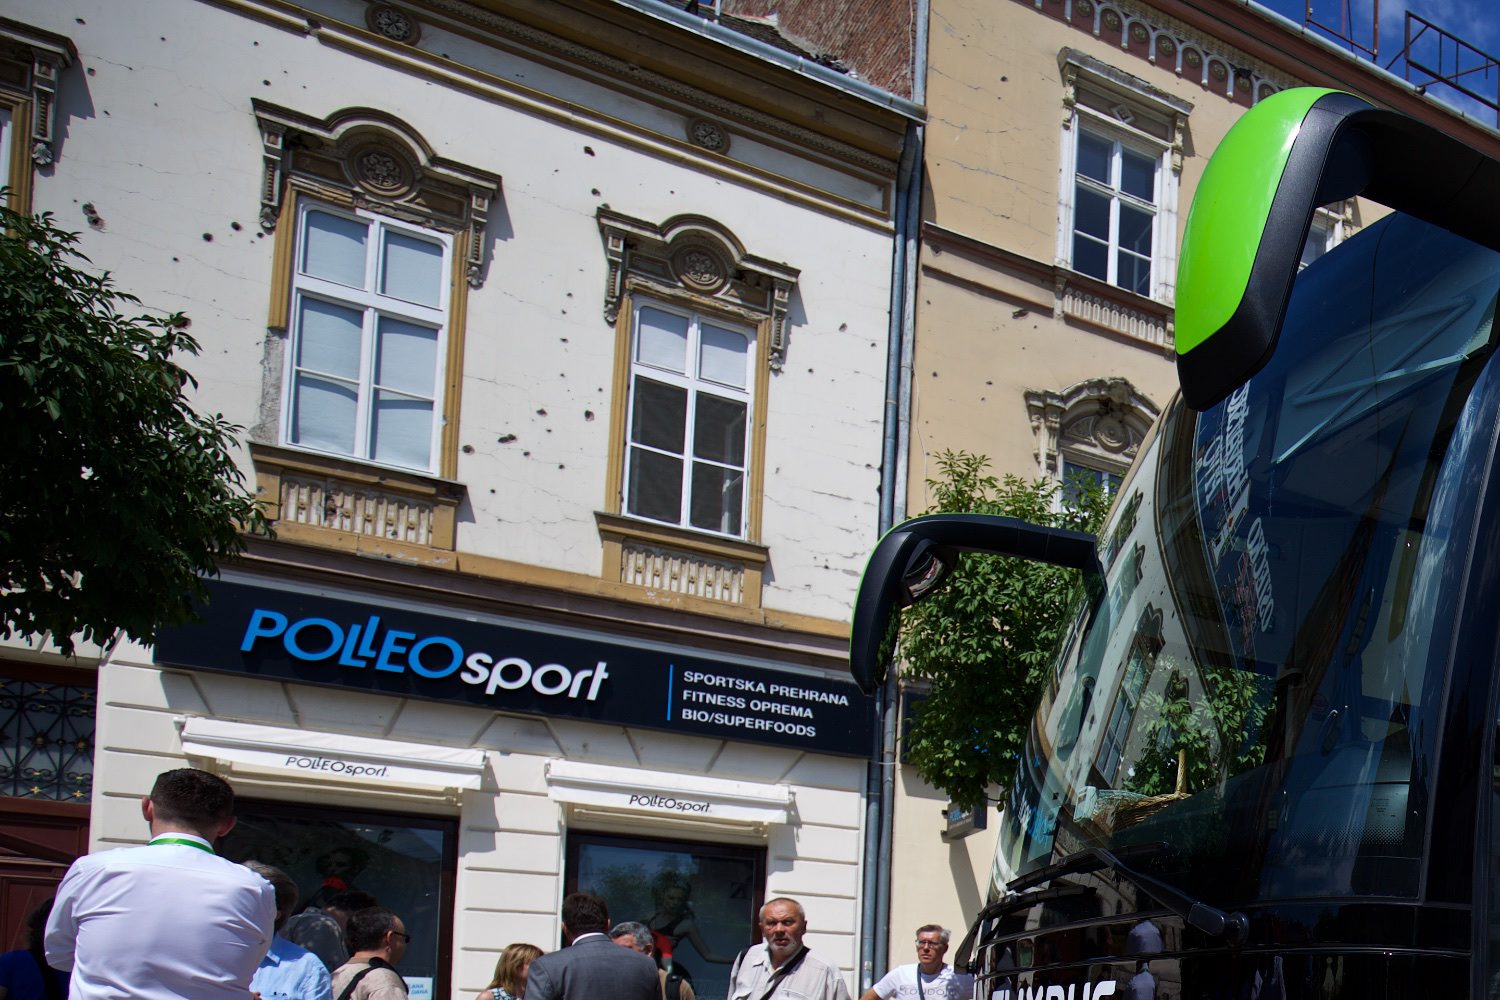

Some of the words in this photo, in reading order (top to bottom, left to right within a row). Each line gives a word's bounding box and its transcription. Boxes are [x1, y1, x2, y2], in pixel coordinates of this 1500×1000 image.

[683, 670, 766, 694] SPORTSKA
[769, 684, 849, 706] PREHRANA
[682, 690, 746, 709] FITNESS
[749, 699, 814, 719] OPREMA
[681, 708, 816, 737] BIO/SUPERFOODS
